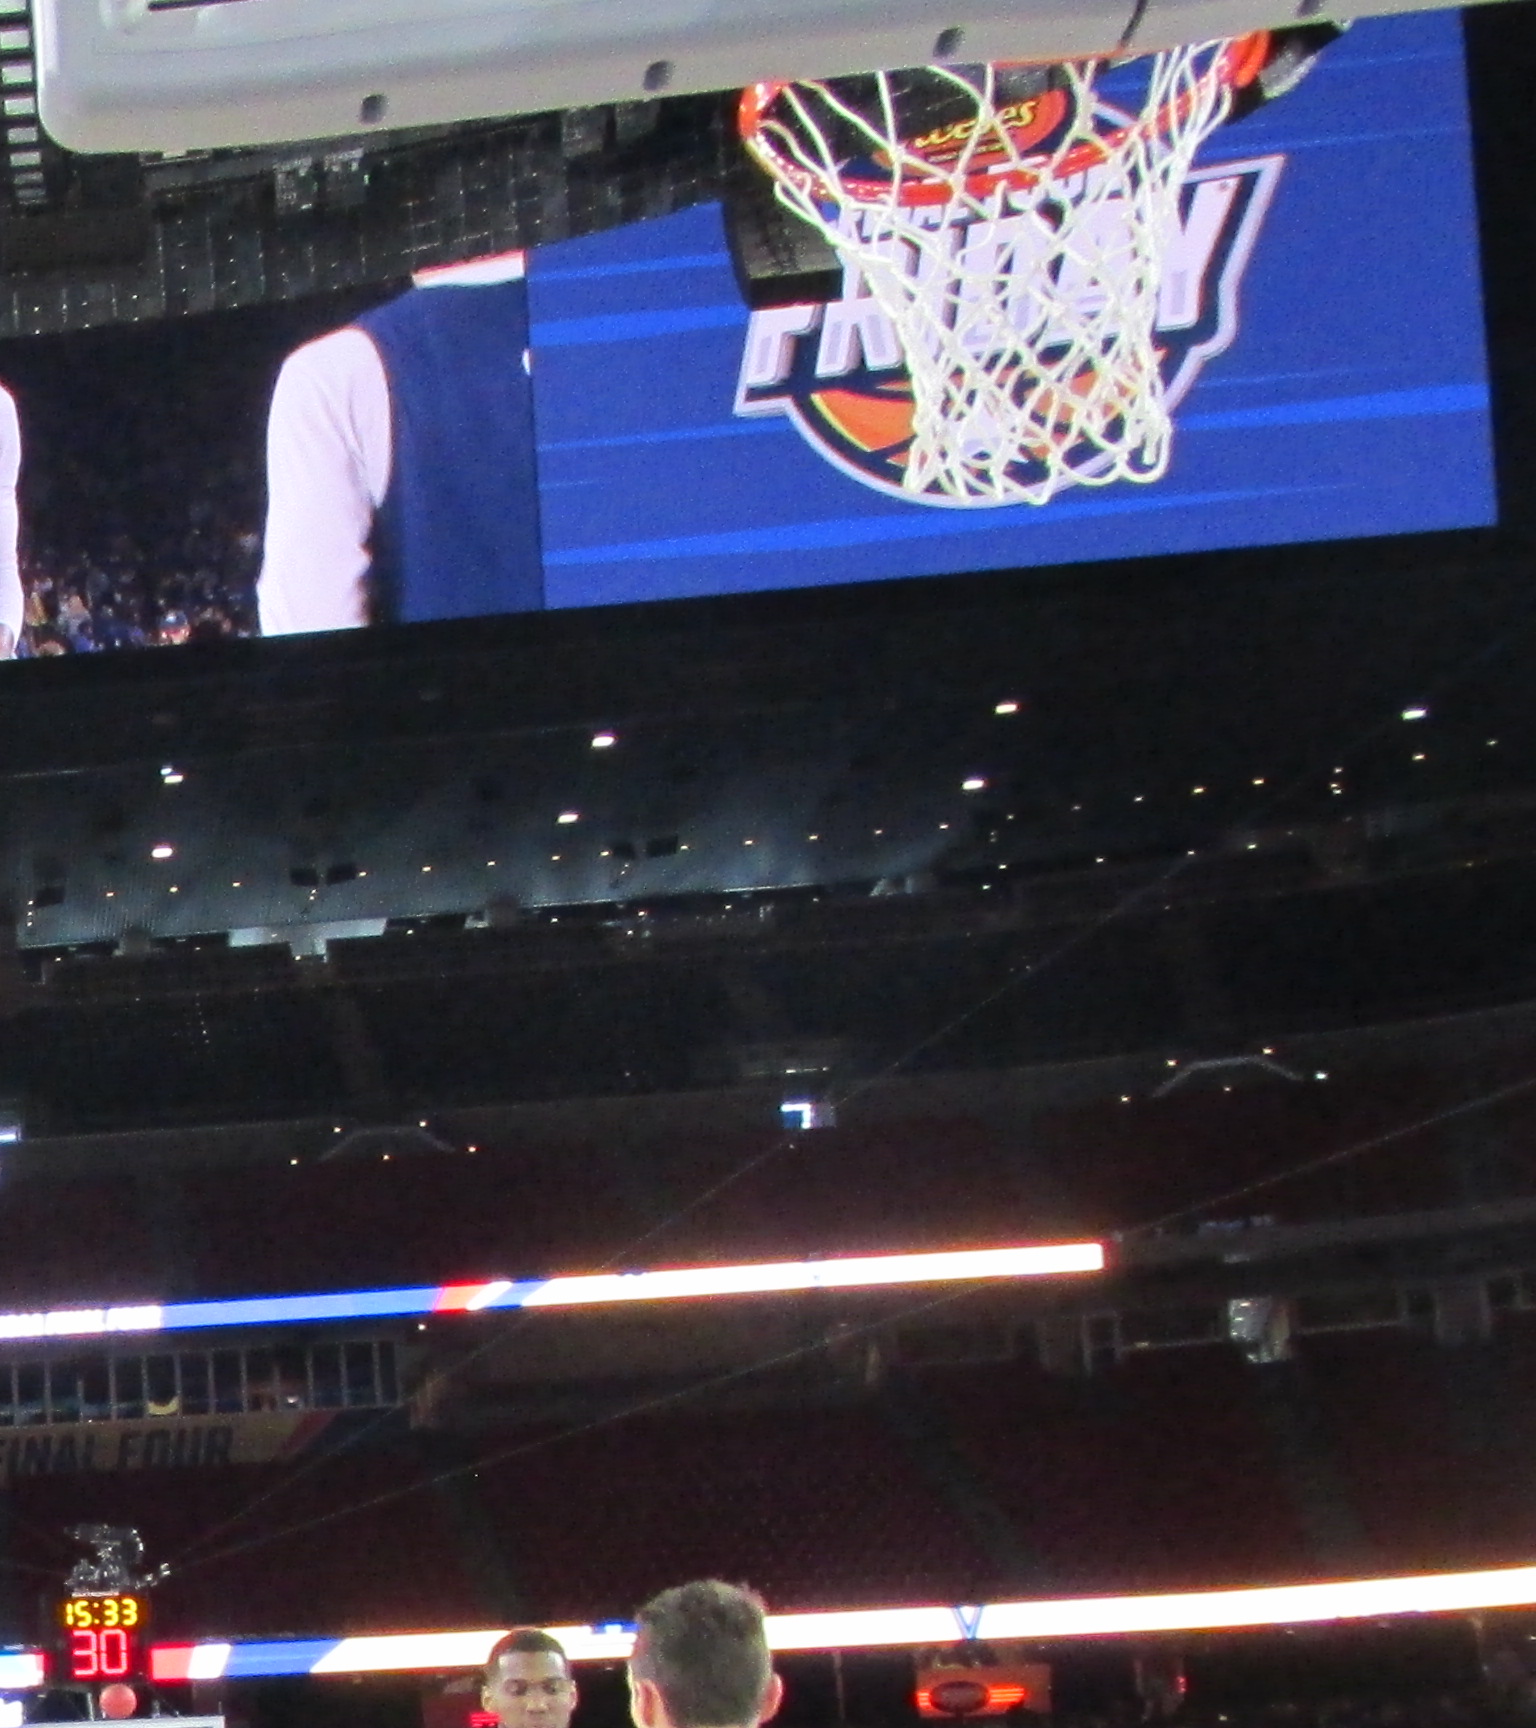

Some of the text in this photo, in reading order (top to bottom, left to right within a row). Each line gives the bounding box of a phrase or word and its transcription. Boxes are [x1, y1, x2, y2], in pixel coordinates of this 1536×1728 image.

[117, 1425, 234, 1470] FOUR
[65, 1598, 138, 1627] 15:33
[73, 1629, 128, 1675] 30
